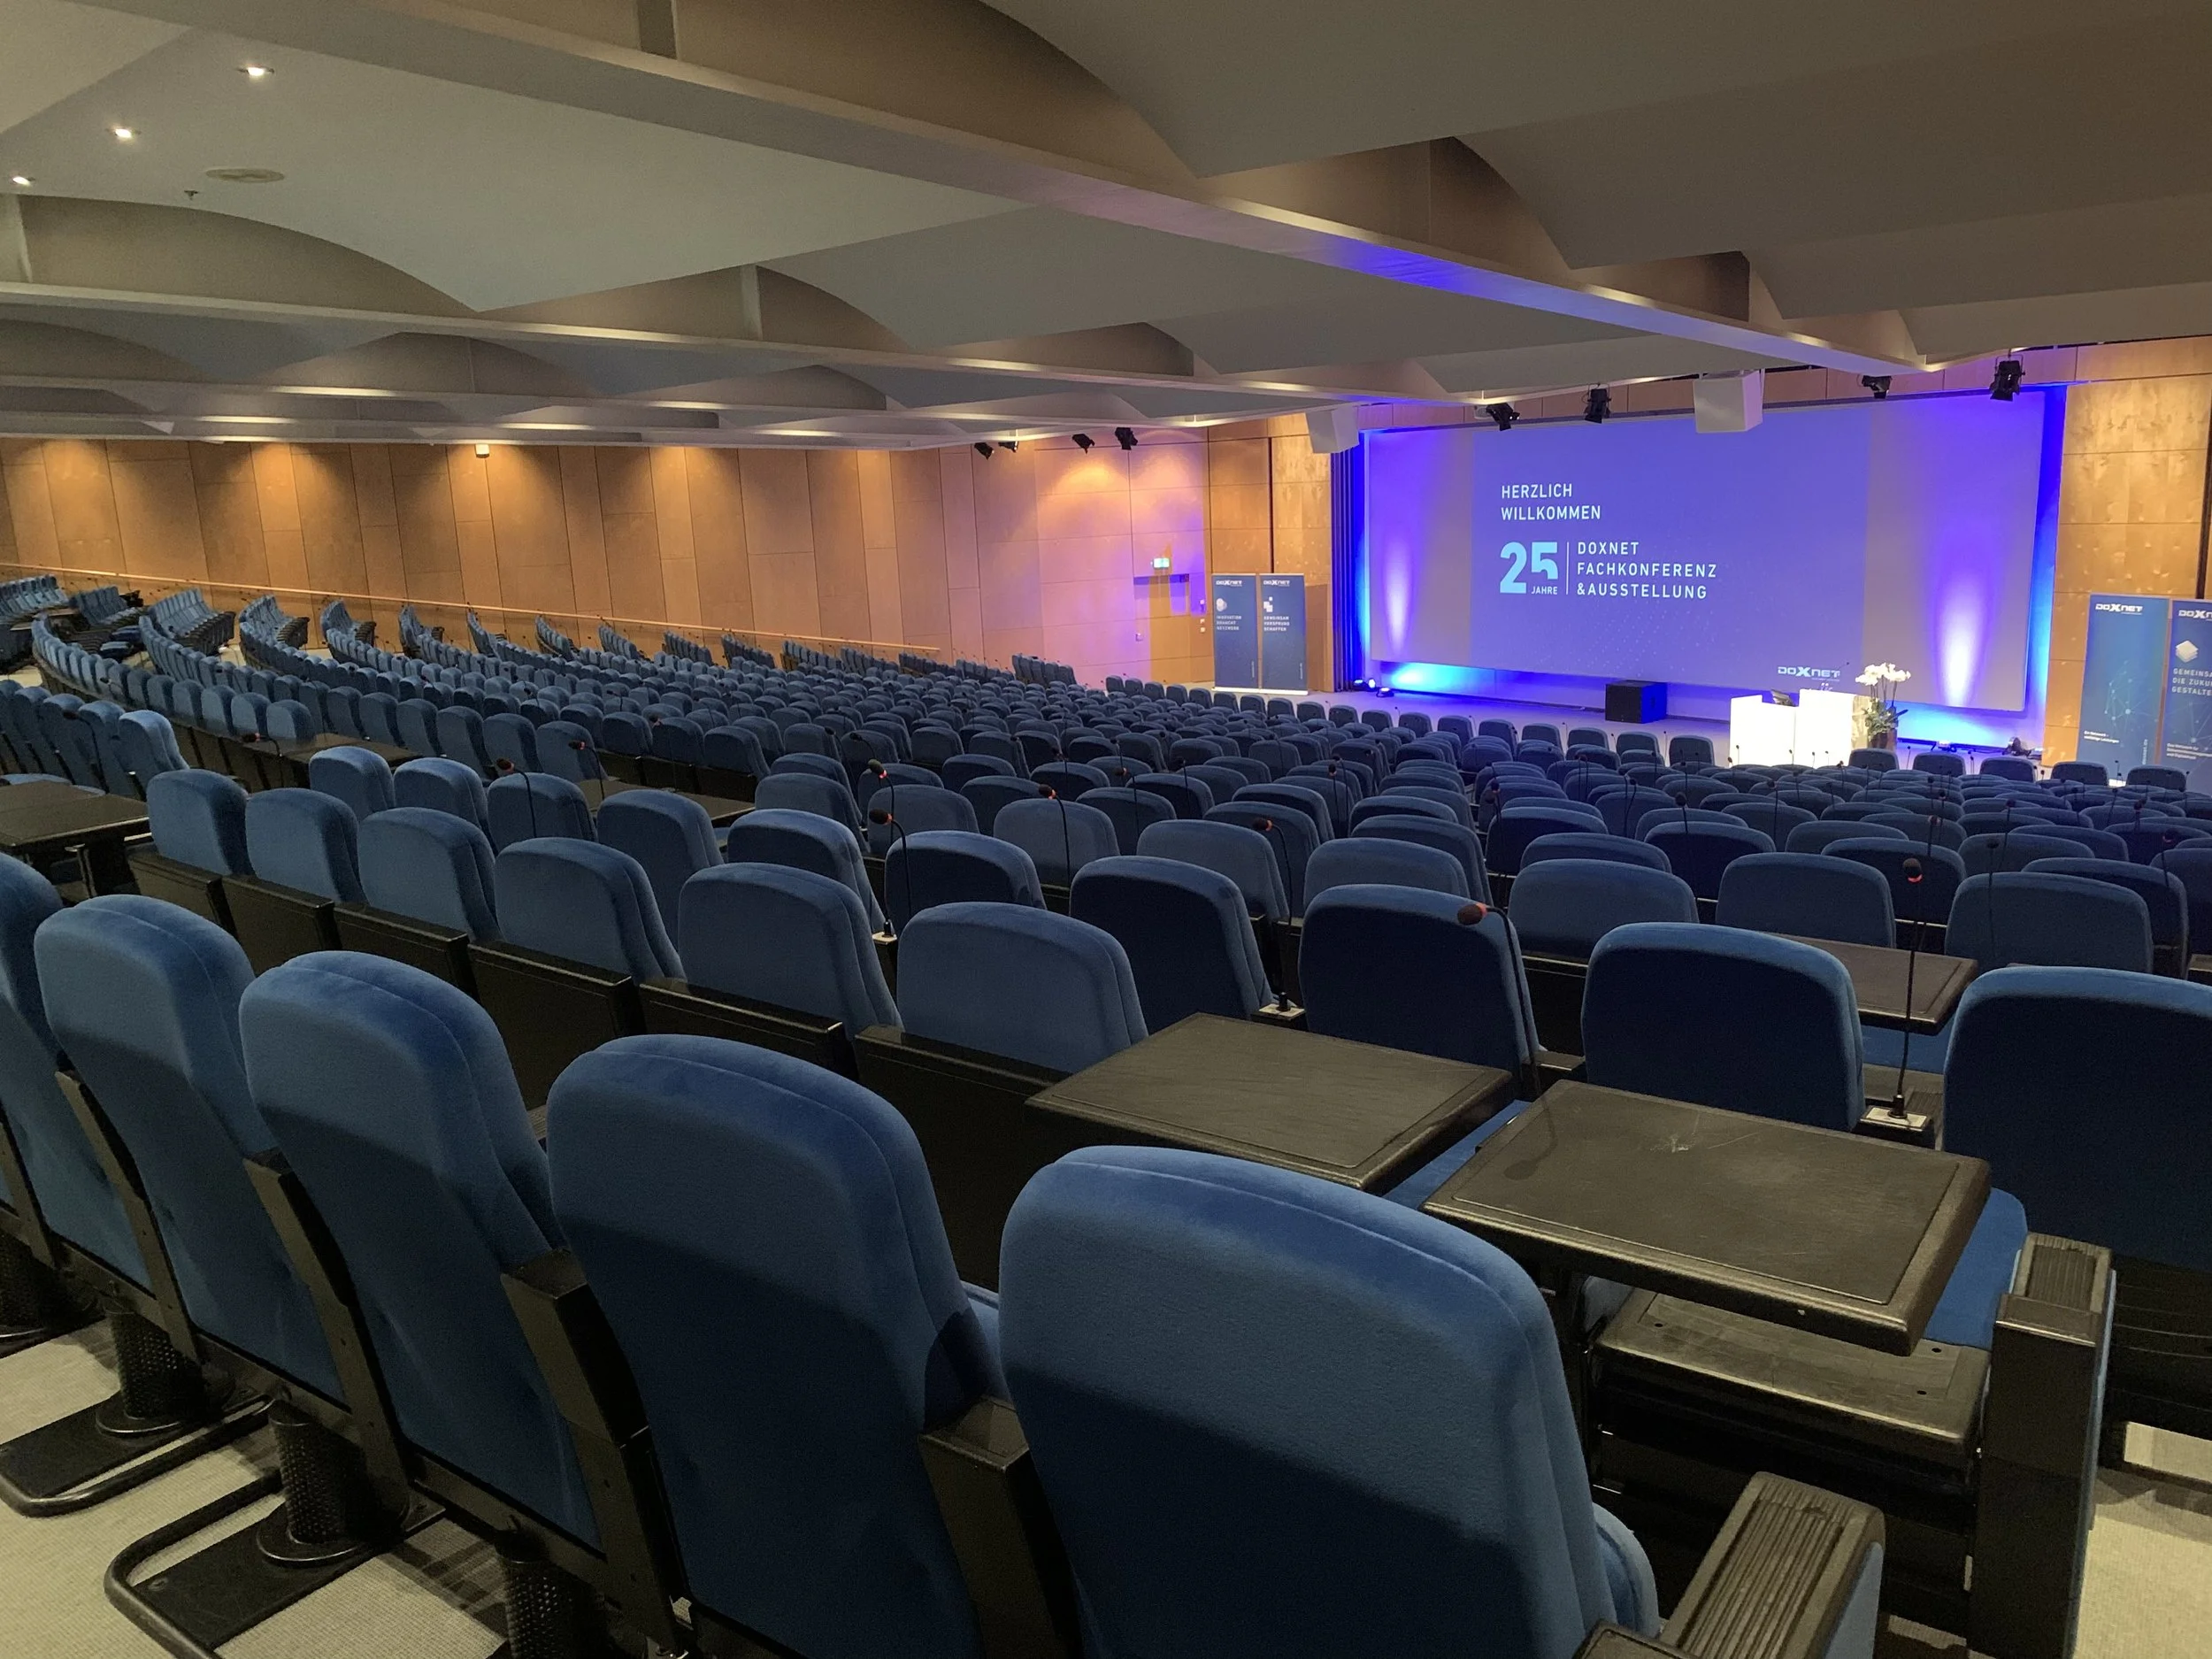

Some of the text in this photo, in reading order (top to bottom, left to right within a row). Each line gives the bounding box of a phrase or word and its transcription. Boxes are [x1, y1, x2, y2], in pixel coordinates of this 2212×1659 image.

[1502, 483, 1572, 499] HERZLICH
[1502, 505, 1601, 521] WILLKOMMEN
[1578, 541, 1639, 555] DOXNET
[1500, 541, 1558, 594] 25
[1578, 562, 1717, 578] FACHKONFERENZ
[1531, 586, 1558, 595] JAHRE
[1577, 583, 1707, 599] &AUSSTELLUNG
[2188, 679, 2212, 687] ZUKU
